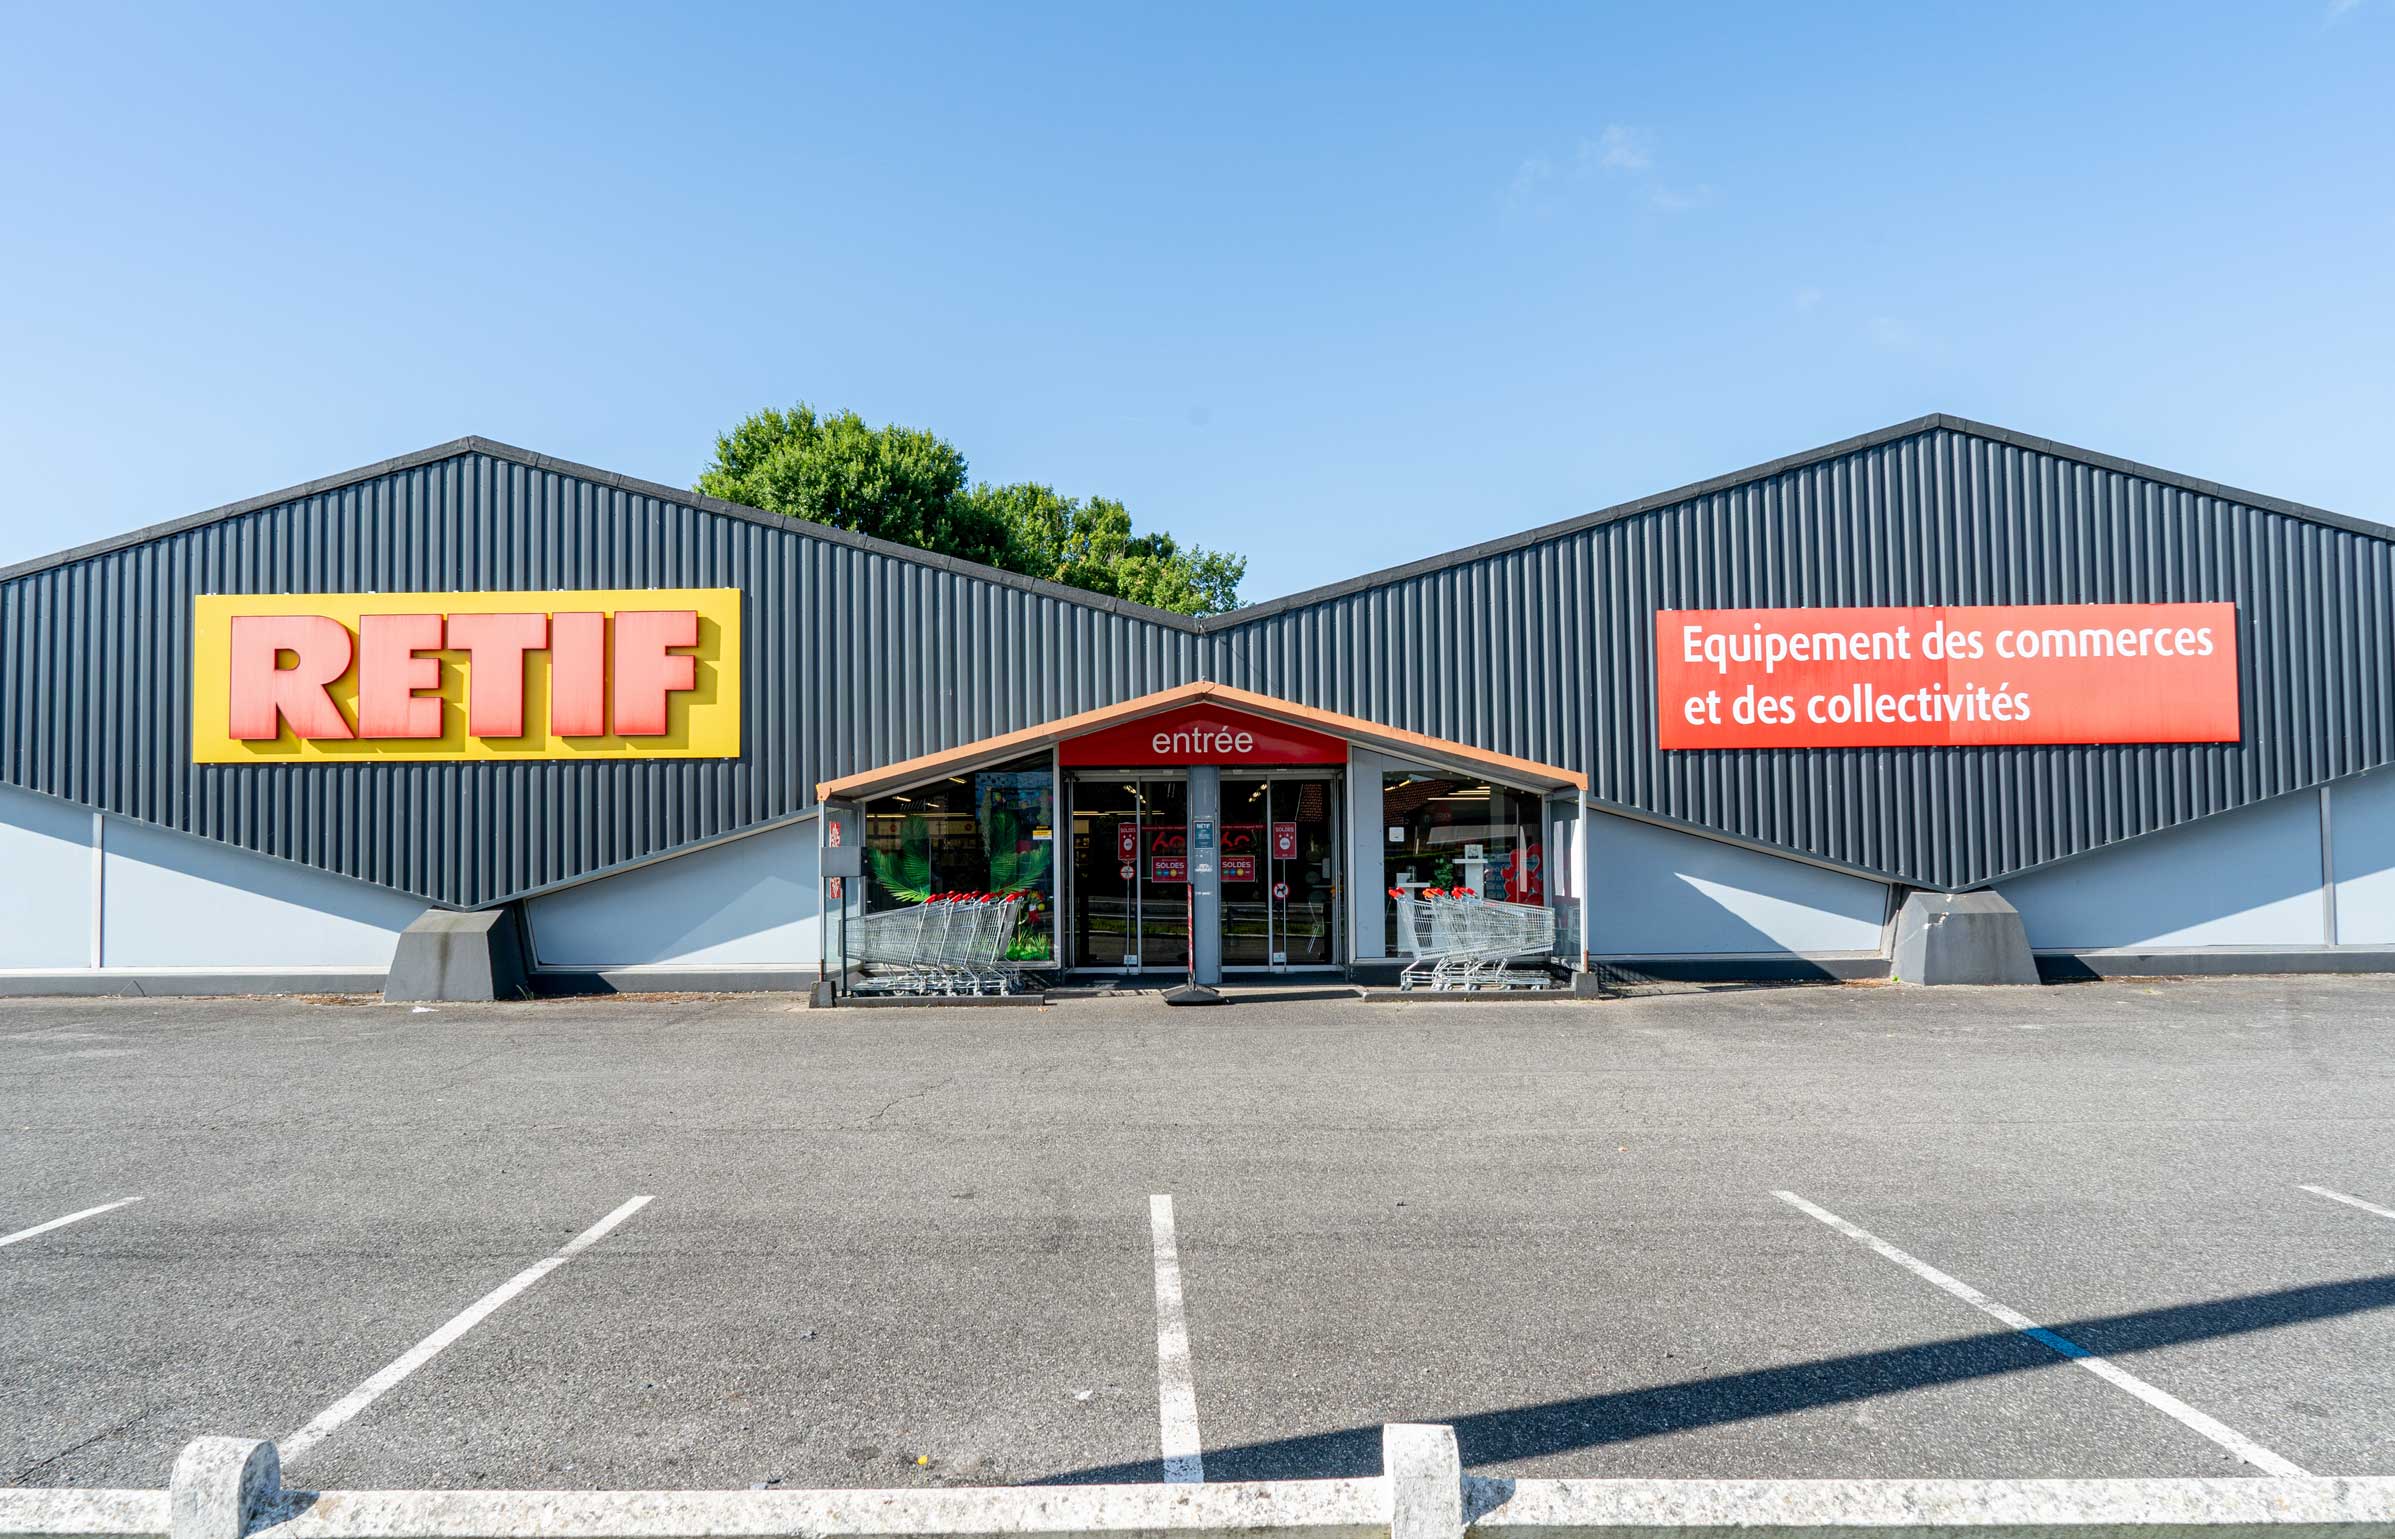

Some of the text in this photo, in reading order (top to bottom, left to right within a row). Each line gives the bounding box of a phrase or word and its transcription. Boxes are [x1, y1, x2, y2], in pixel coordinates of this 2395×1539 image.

[1683, 620, 2214, 674] Equipement des commerces
[229, 610, 699, 740] RETIF
[1684, 682, 2031, 725] et des collectivités
[1152, 725, 1254, 754] entrée
